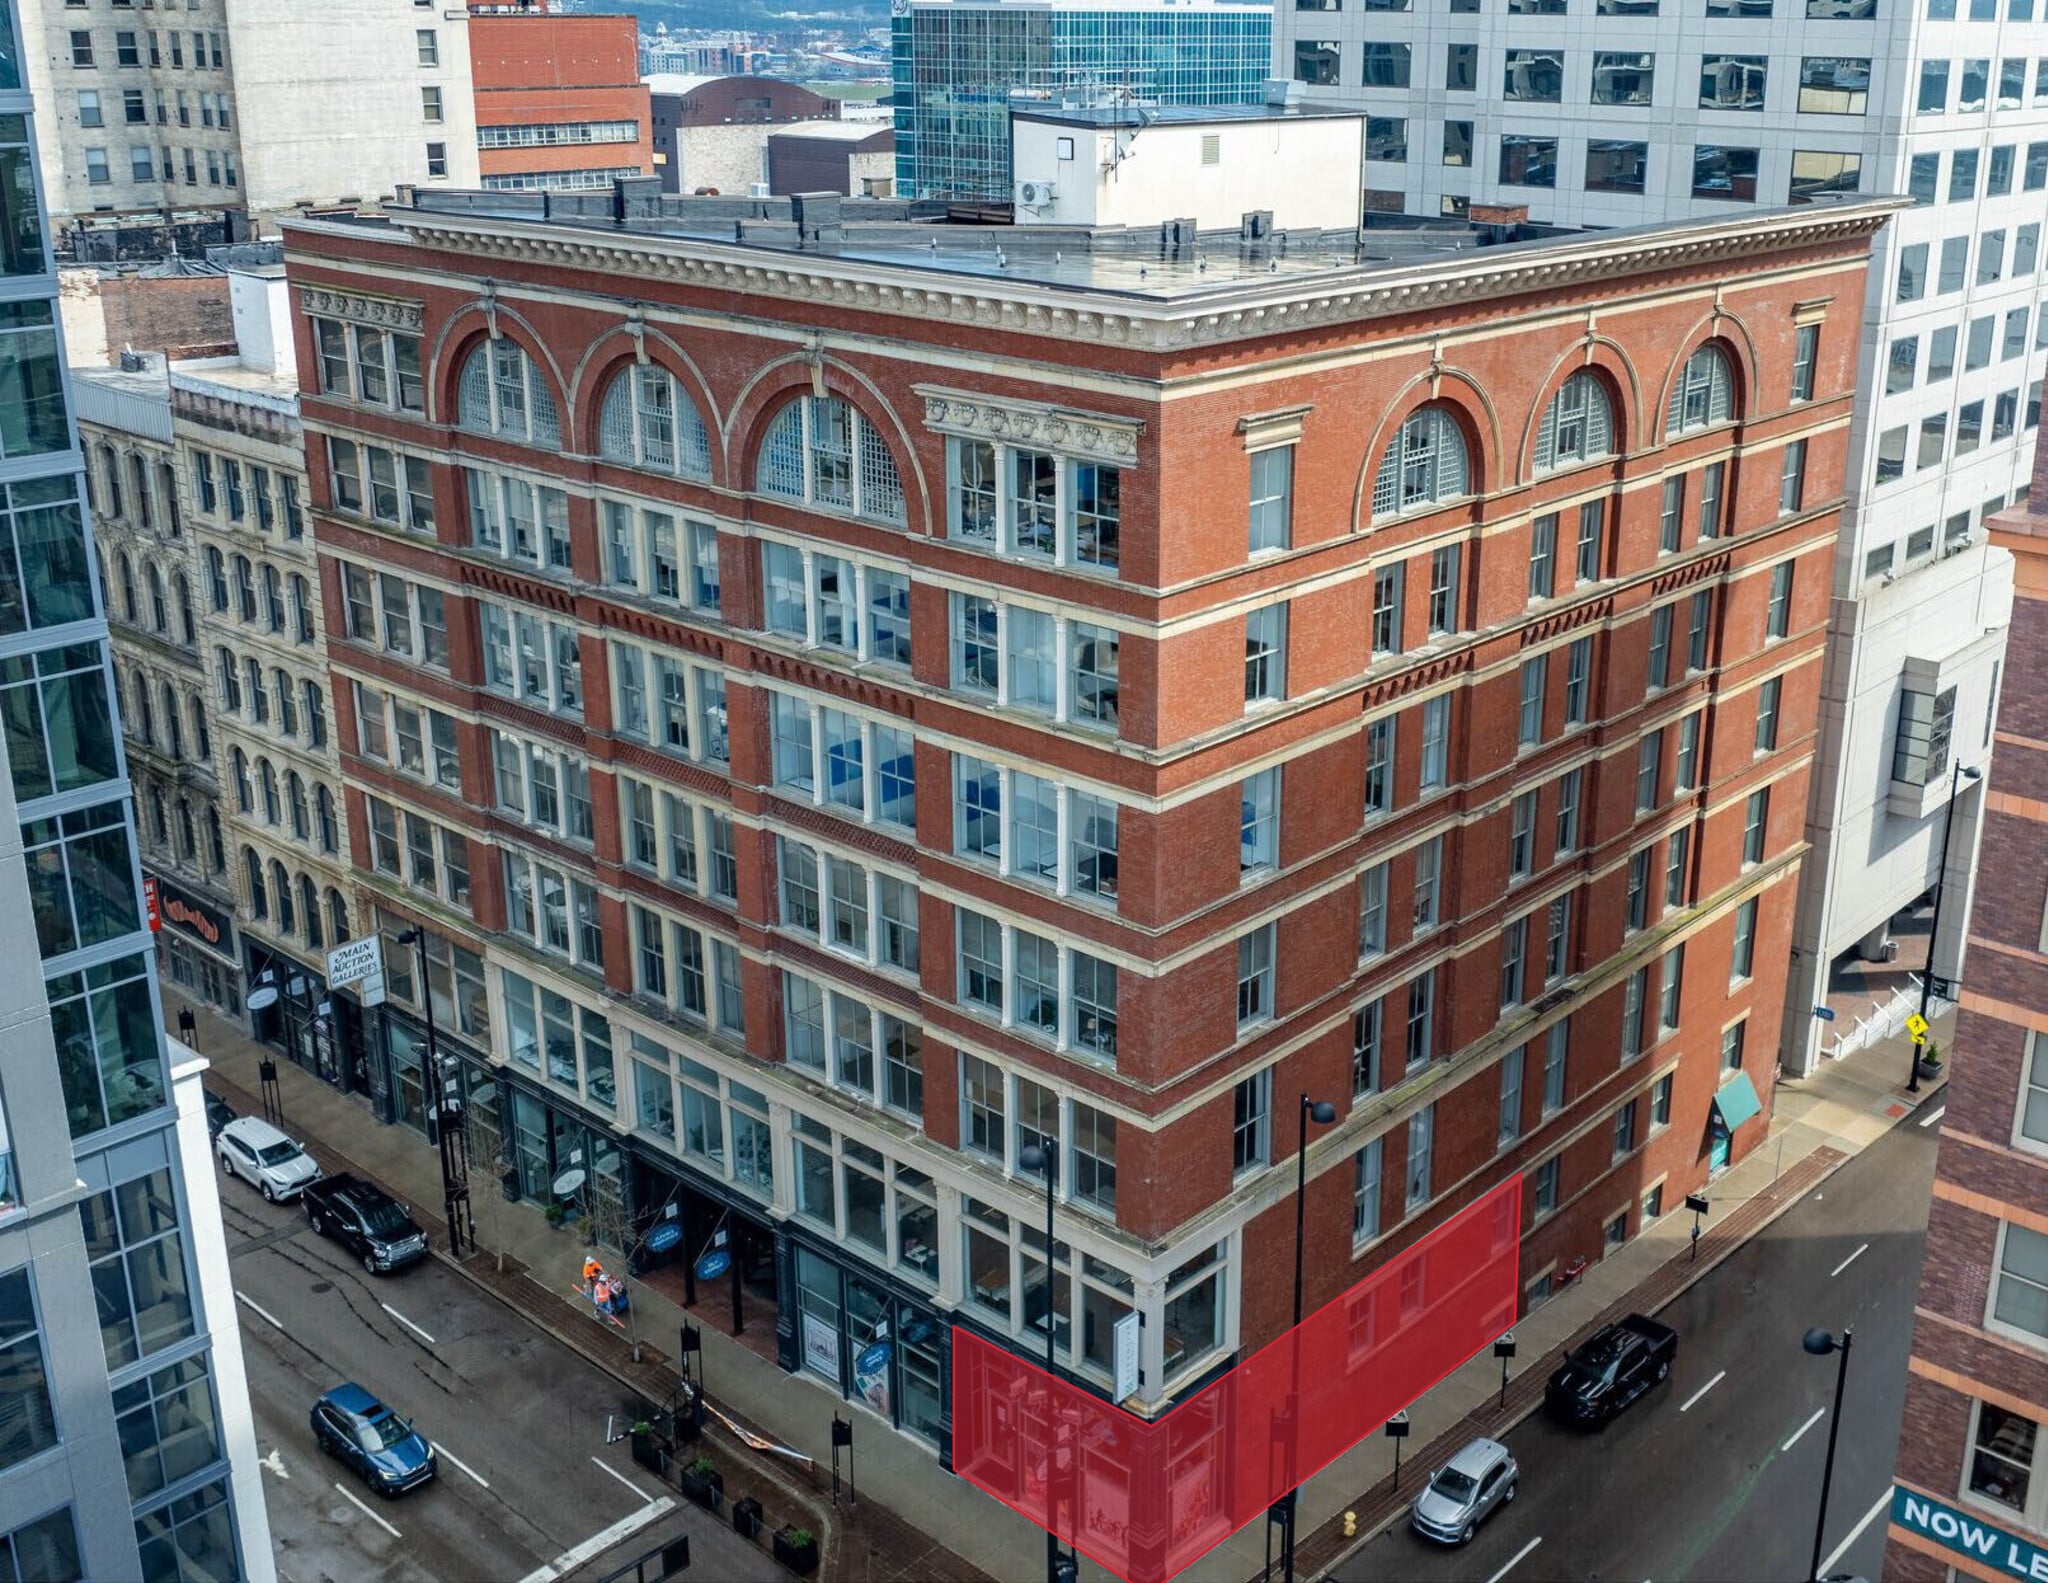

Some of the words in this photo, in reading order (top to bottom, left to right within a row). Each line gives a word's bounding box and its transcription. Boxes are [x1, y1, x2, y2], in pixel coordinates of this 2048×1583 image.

[332, 952, 374, 974] AUCTION
[335, 942, 370, 963] MAIN
[332, 962, 377, 984] GALLERIES
[1904, 1497, 1998, 1555] NOW
